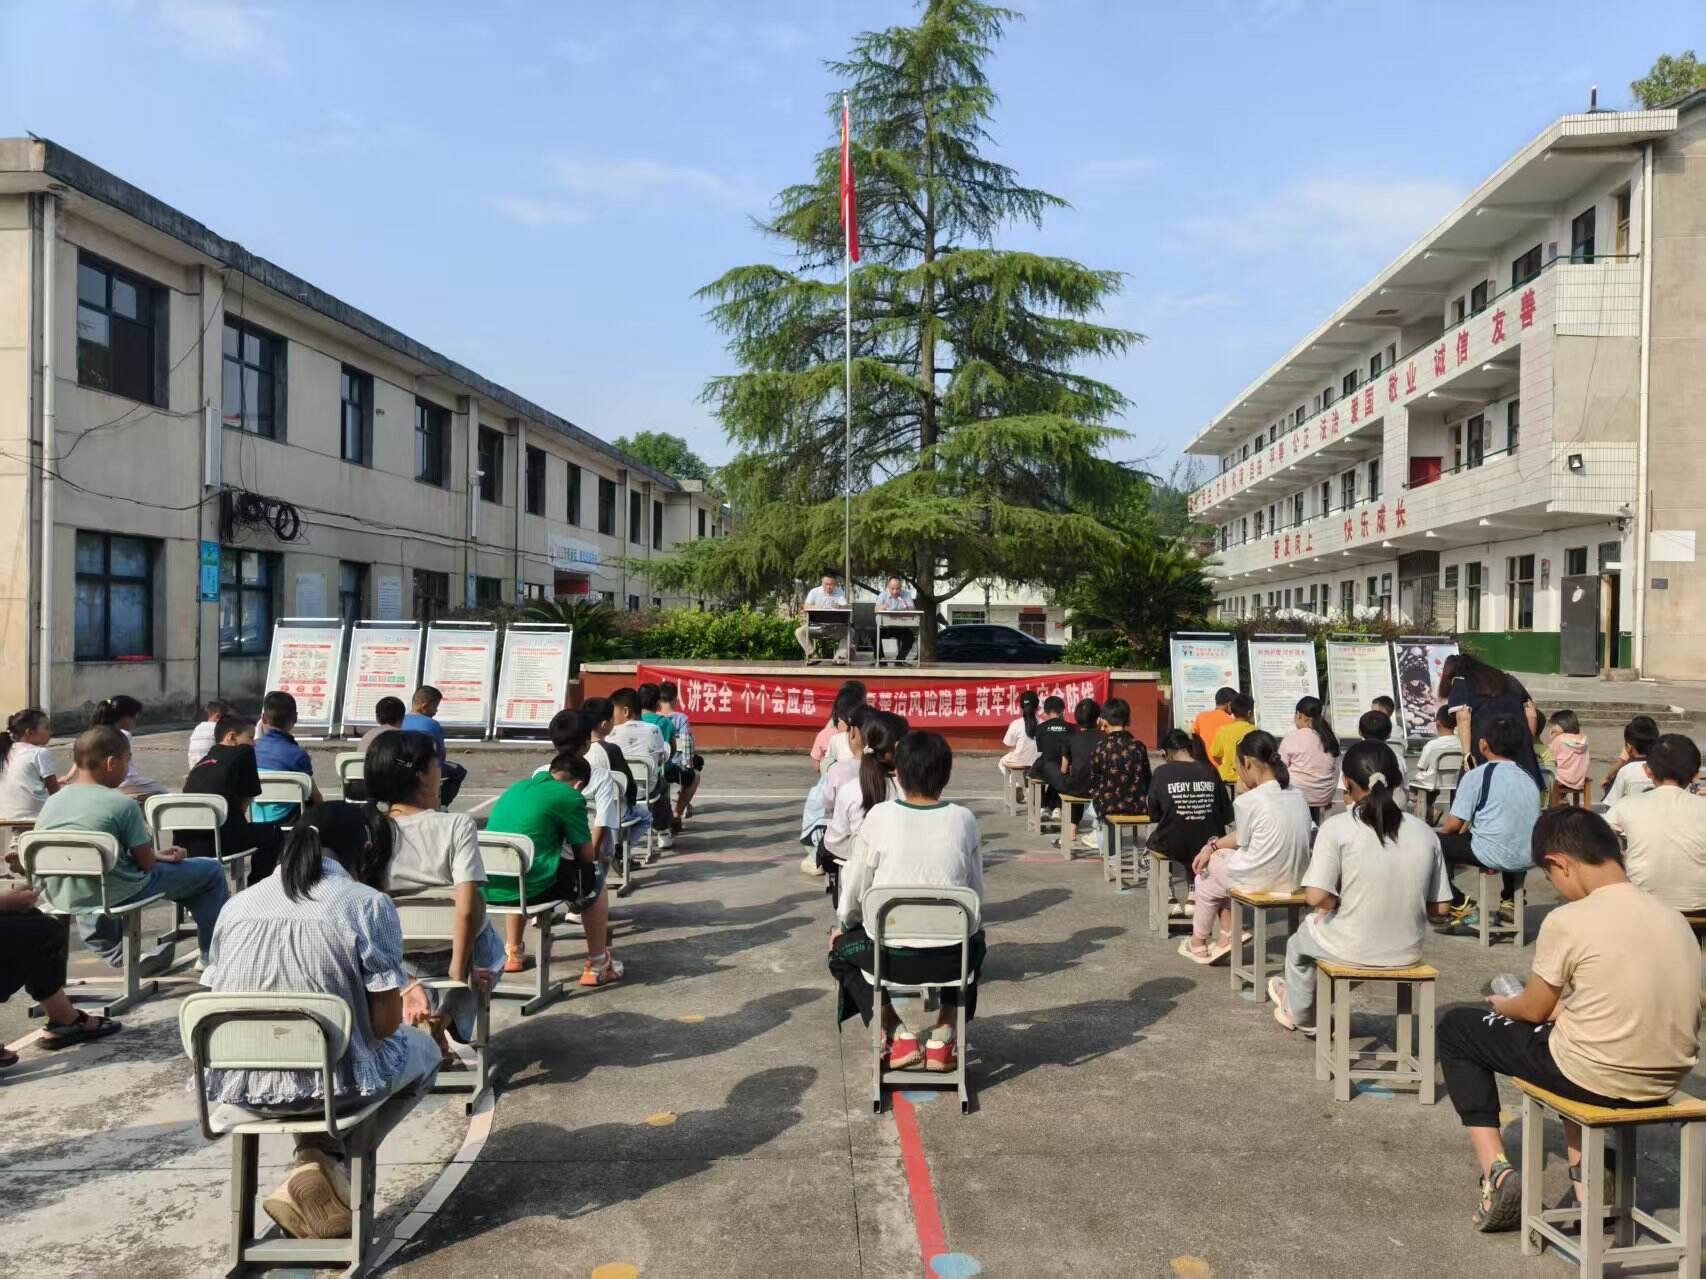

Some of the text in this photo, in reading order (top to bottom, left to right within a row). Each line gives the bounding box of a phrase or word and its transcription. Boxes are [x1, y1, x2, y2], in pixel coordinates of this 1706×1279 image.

[1434, 328, 1469, 378] 诚信
[1492, 287, 1536, 345] 友善
[1344, 498, 1406, 544] 快乐成长
[662, 677, 733, 712] 人讲安全
[741, 683, 816, 715] 个个会应急
[975, 680, 1095, 717] 筑牢北安防线
[1168, 782, 1191, 794] EVERY
